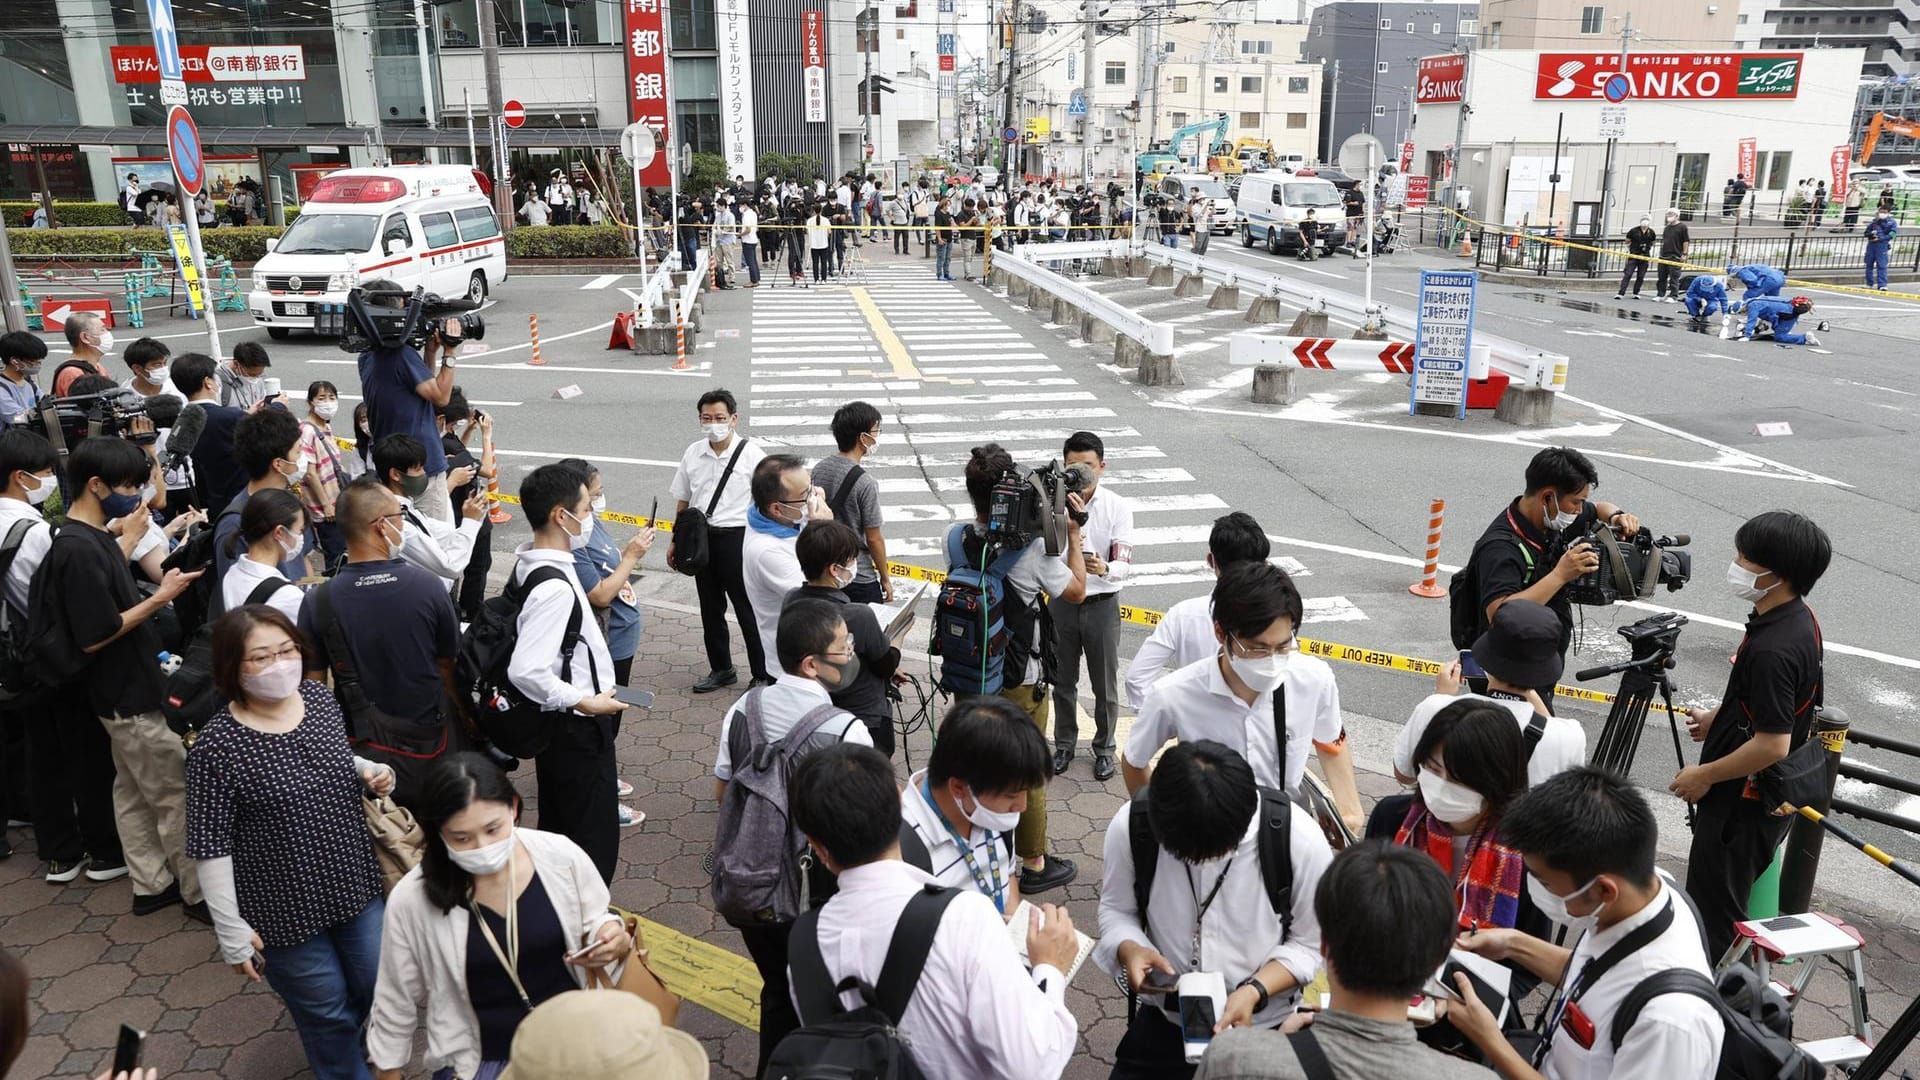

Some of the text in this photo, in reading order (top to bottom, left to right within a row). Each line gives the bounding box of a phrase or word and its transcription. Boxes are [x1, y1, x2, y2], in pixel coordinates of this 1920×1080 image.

[211, 54, 298, 71] @南都銀行
[1423, 306, 1469, 320] 工事を行っています
[891, 564, 911, 577] KEEP
[1309, 640, 1333, 657] 消防
[1341, 647, 1363, 661] OUT
[1365, 651, 1393, 667] KEEP
